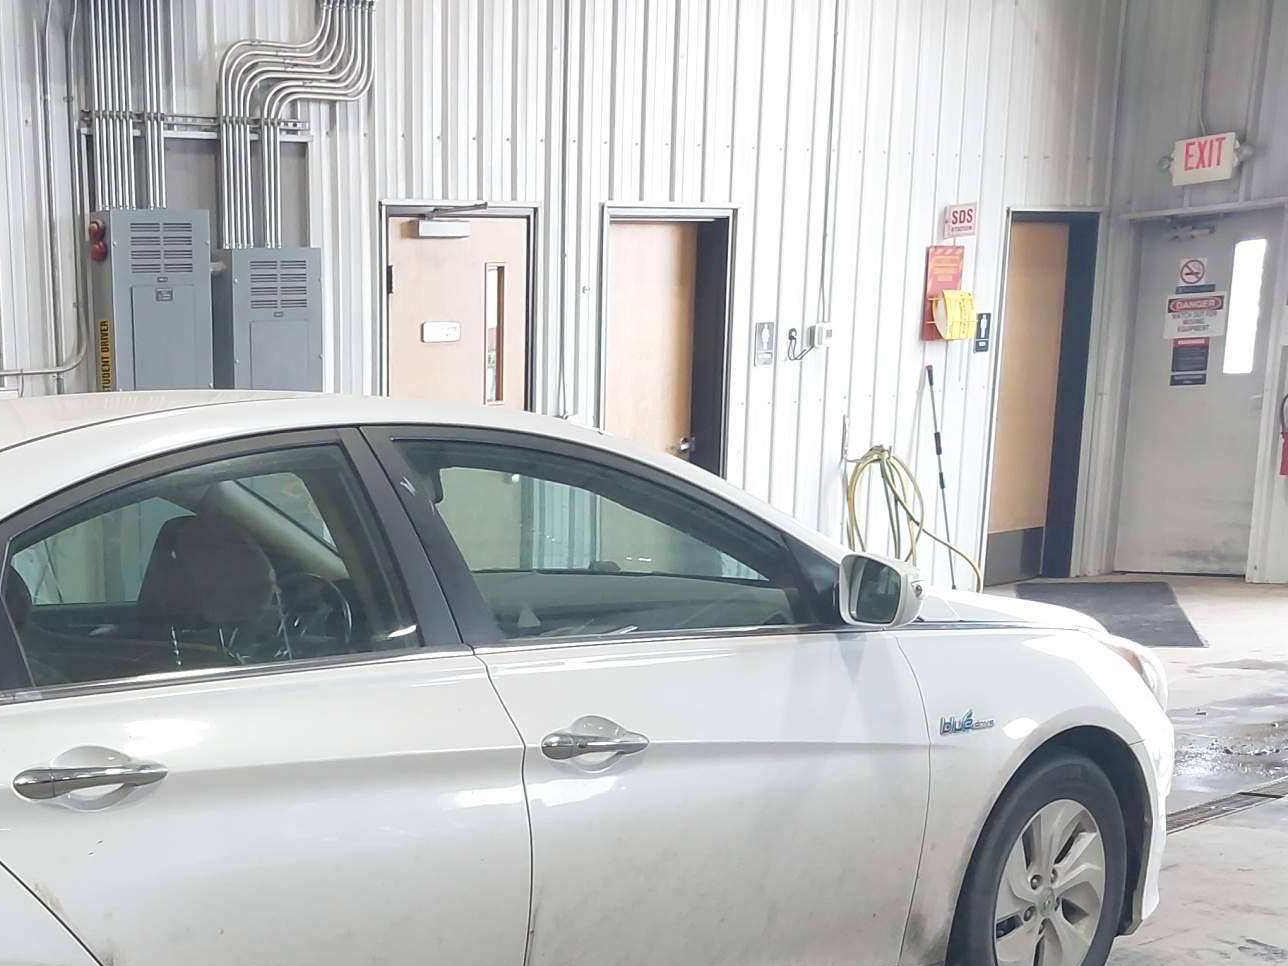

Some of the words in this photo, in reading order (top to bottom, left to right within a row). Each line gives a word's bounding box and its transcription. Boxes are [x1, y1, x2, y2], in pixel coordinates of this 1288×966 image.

[1184, 137, 1226, 171] EXIT
[952, 208, 973, 225] SDS
[1175, 299, 1216, 310] DANGER
[99, 320, 109, 352] DRIVER
